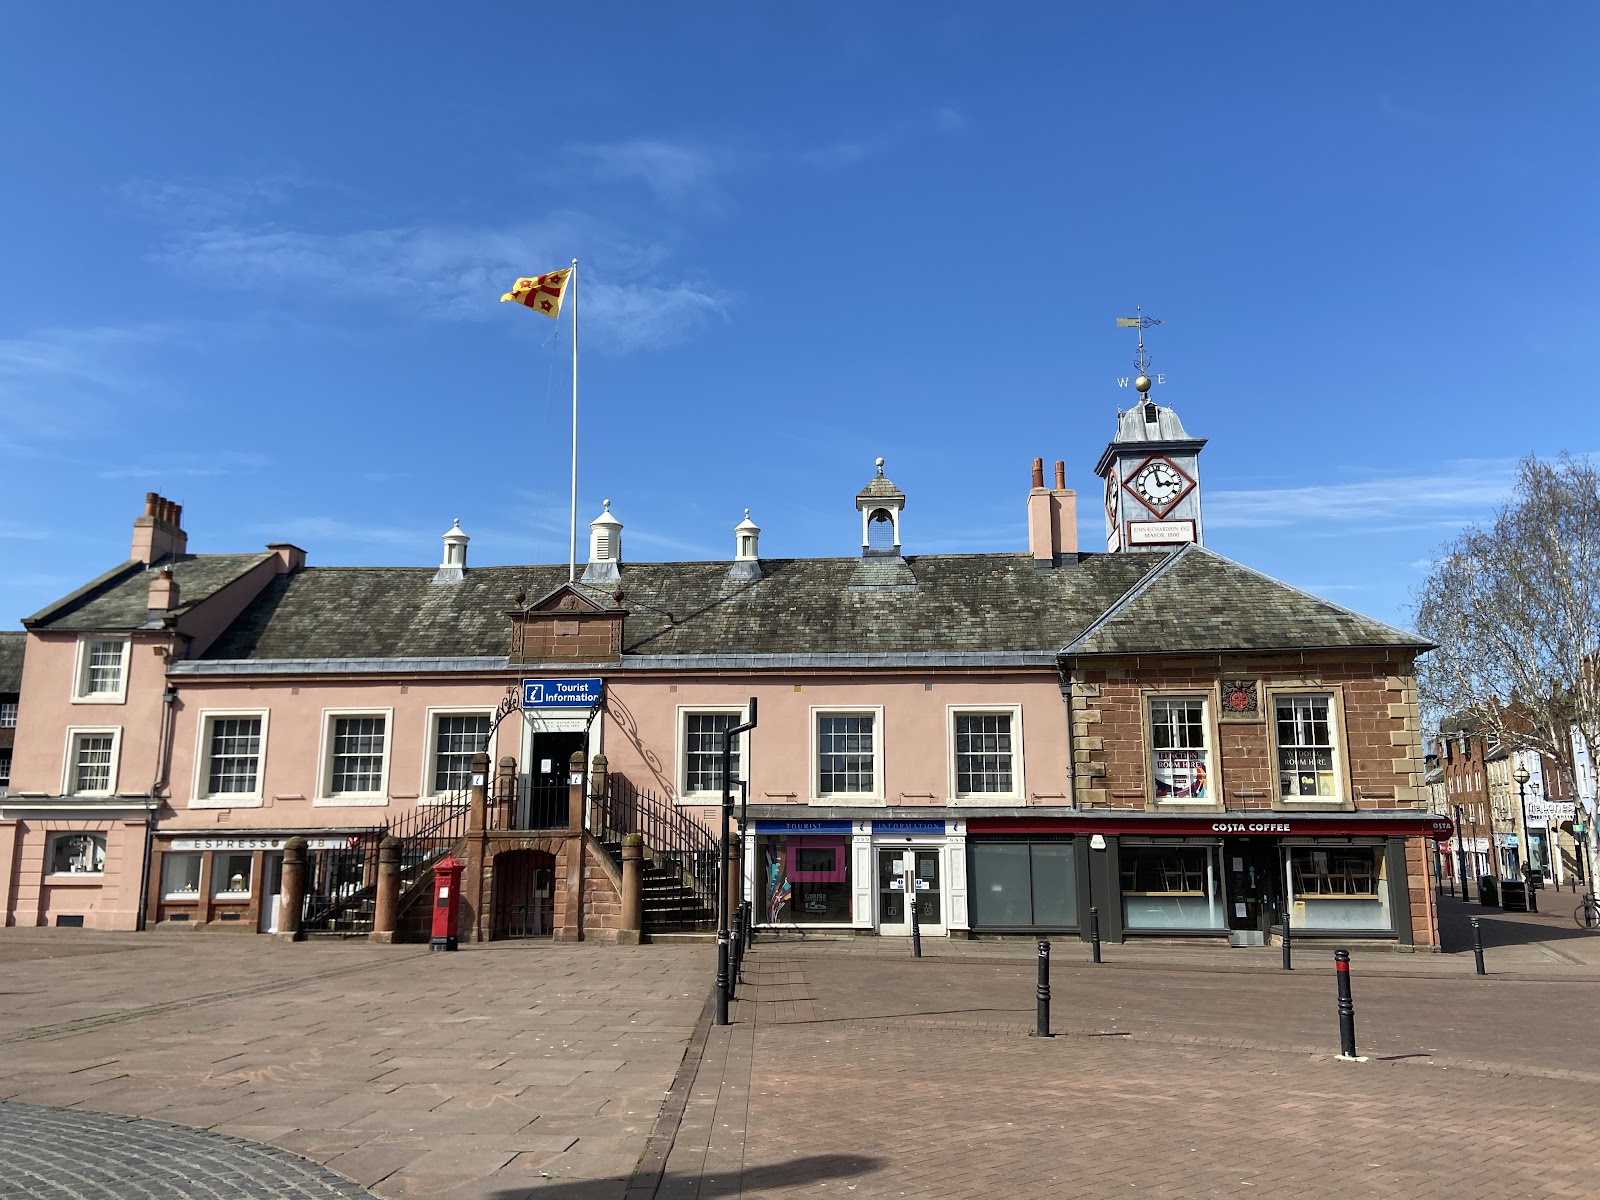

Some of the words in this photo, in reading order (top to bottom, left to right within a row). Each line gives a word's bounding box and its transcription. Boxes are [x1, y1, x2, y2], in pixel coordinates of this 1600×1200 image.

[1116, 377, 1129, 388] W
[1157, 373, 1166, 384] E
[556, 683, 589, 692] Tourist
[1308, 758, 1327, 766] HRE
[1212, 823, 1246, 832] COSTA
[1248, 823, 1291, 832] COFFEE
